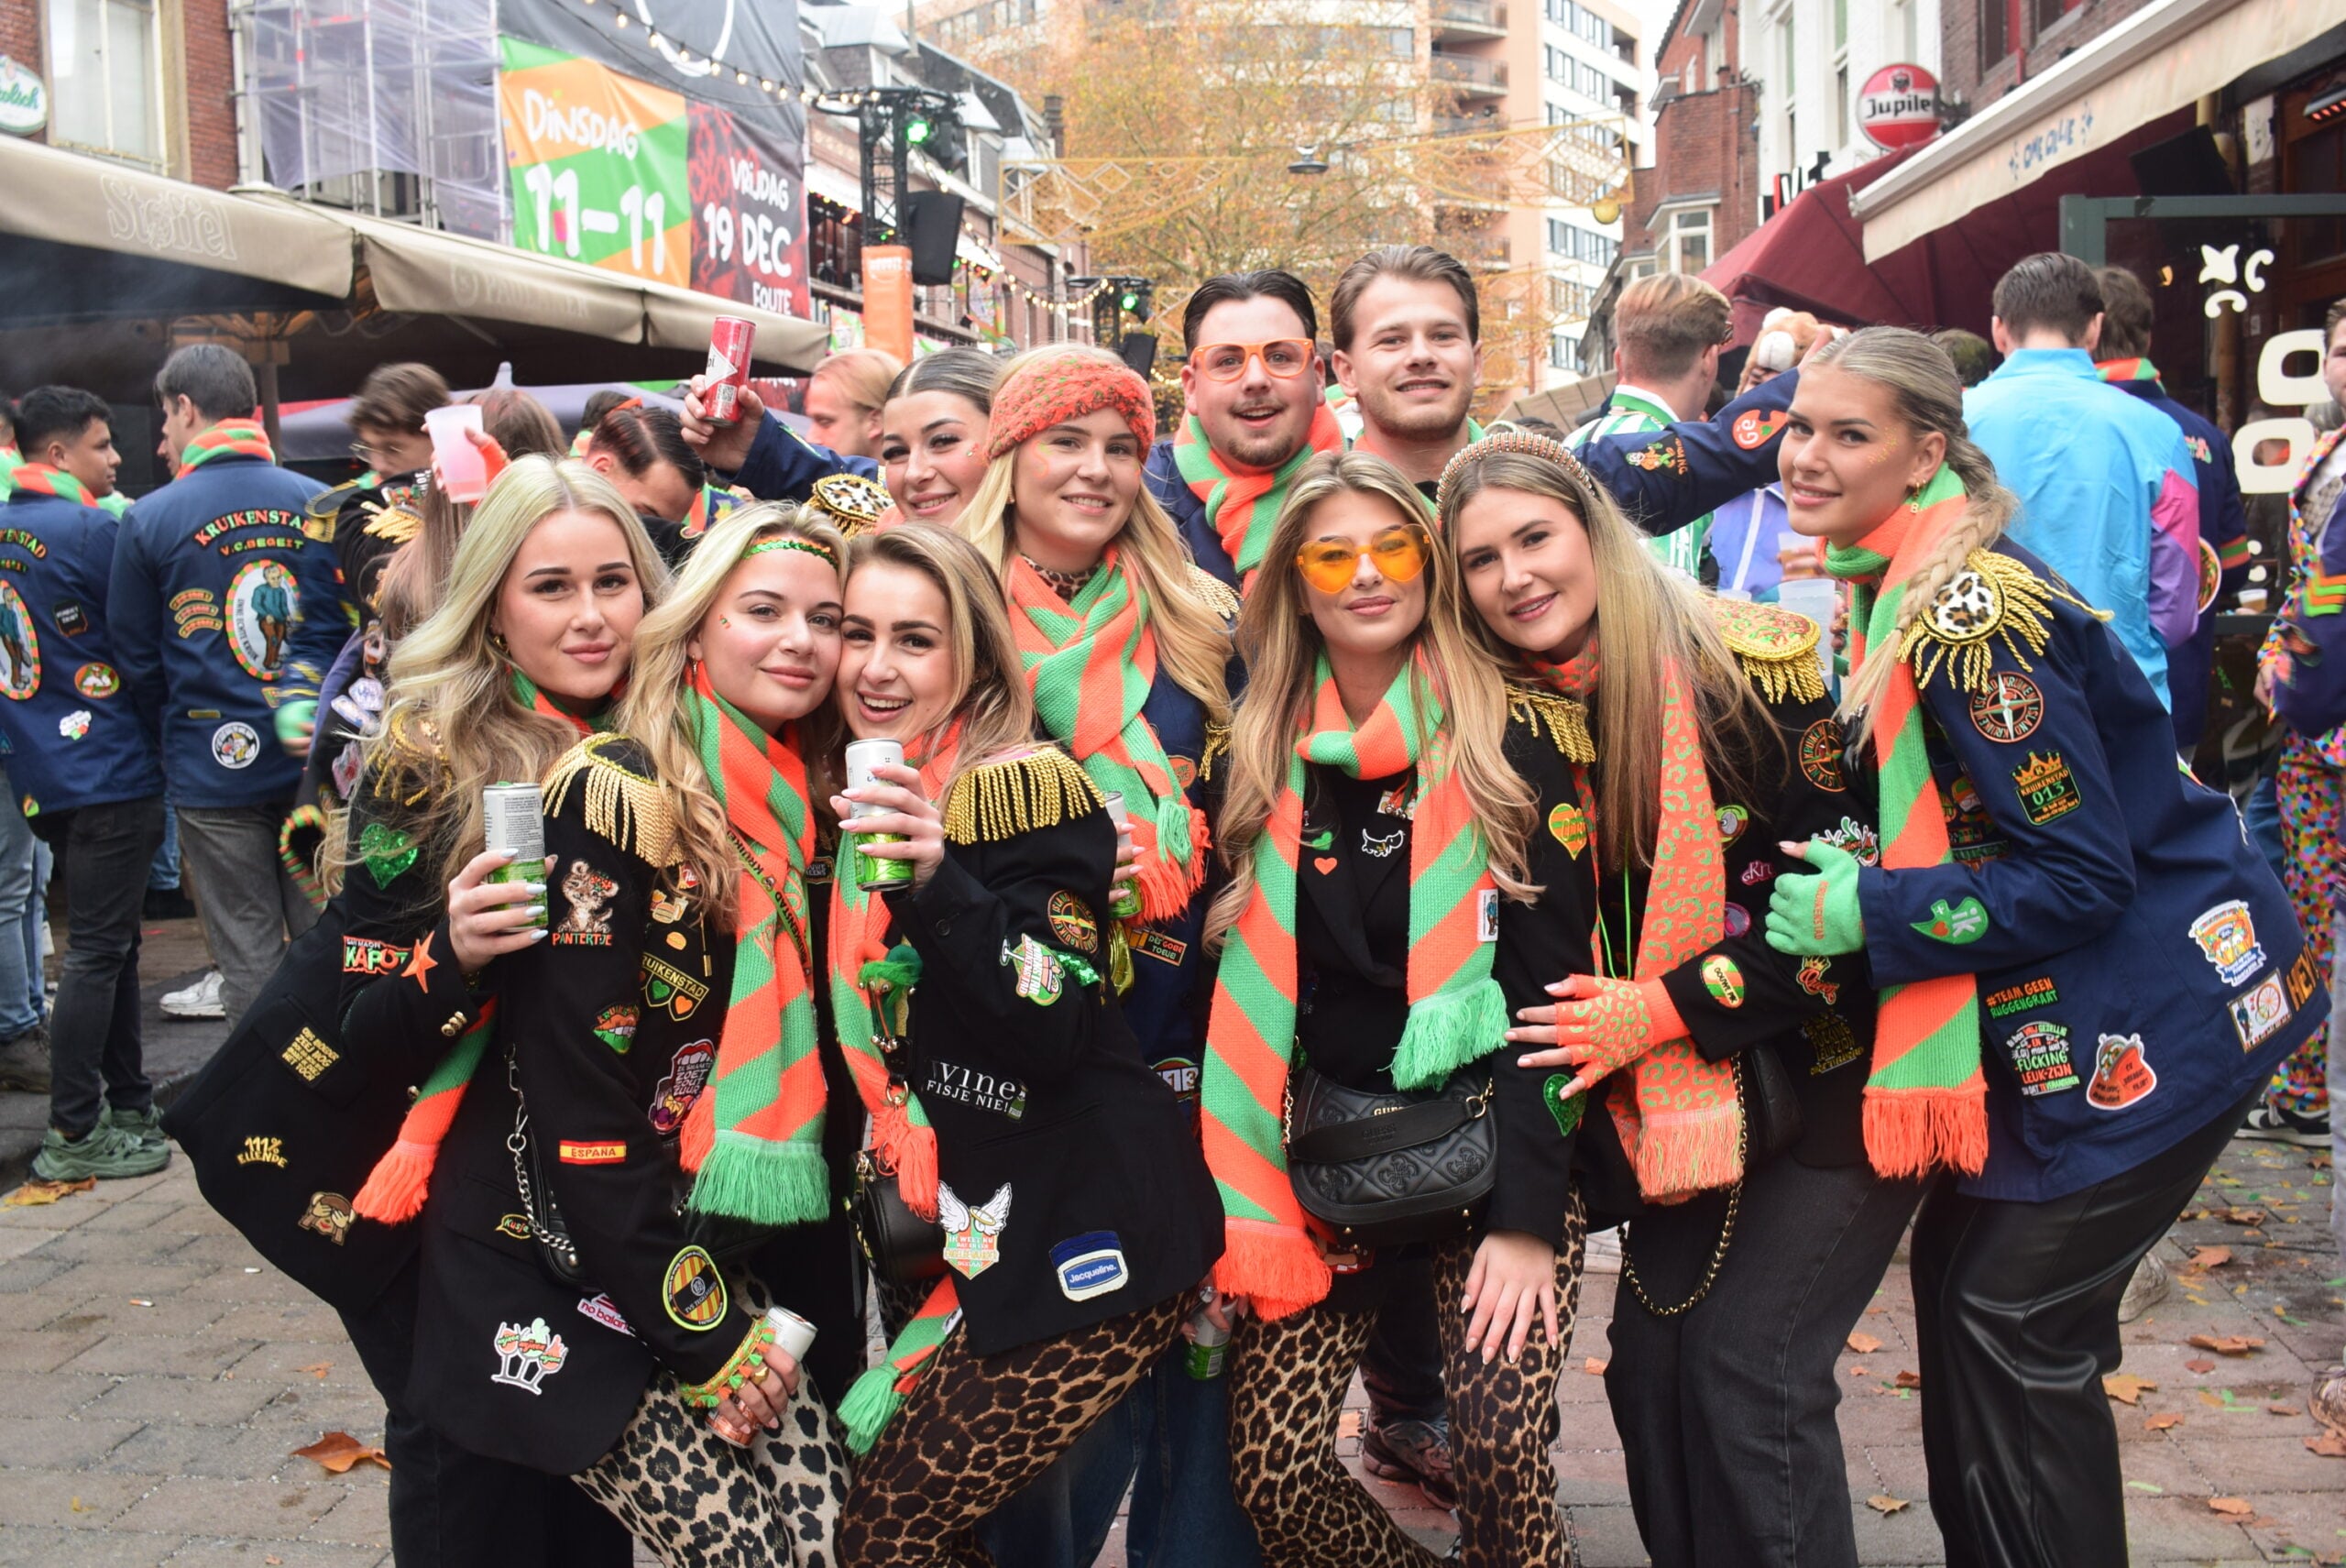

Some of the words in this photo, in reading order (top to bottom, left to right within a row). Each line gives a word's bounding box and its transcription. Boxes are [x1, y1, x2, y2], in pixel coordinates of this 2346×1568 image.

[1866, 95, 1932, 119] Jupile
[523, 89, 639, 160] DINSDAG
[729, 157, 789, 212] VRIJDAG
[523, 162, 666, 275] 11-11
[703, 202, 734, 262] 19
[740, 213, 792, 278] DEC
[752, 281, 793, 317] FOUTE
[2021, 770, 2069, 797] KRUIKENSTAD
[2032, 781, 2065, 806] 013
[552, 932, 613, 946] PANTERTJE
[345, 946, 409, 970] KAPOT
[1986, 986, 2023, 1007] #TEAM
[2023, 976, 2054, 995] GEEN
[1990, 989, 2058, 1019] RUGGENGRAAT
[2016, 1050, 2068, 1073] FUCKING
[676, 1069, 709, 1080] ZOET
[673, 1085, 700, 1097] ZUUR
[926, 1080, 971, 1102] FISJE
[975, 1093, 1009, 1113] NIE!
[245, 1136, 281, 1155] 111%
[236, 1152, 289, 1168] ELLENDE
[504, 1218, 529, 1234] Kusje
[581, 1301, 596, 1314] no
